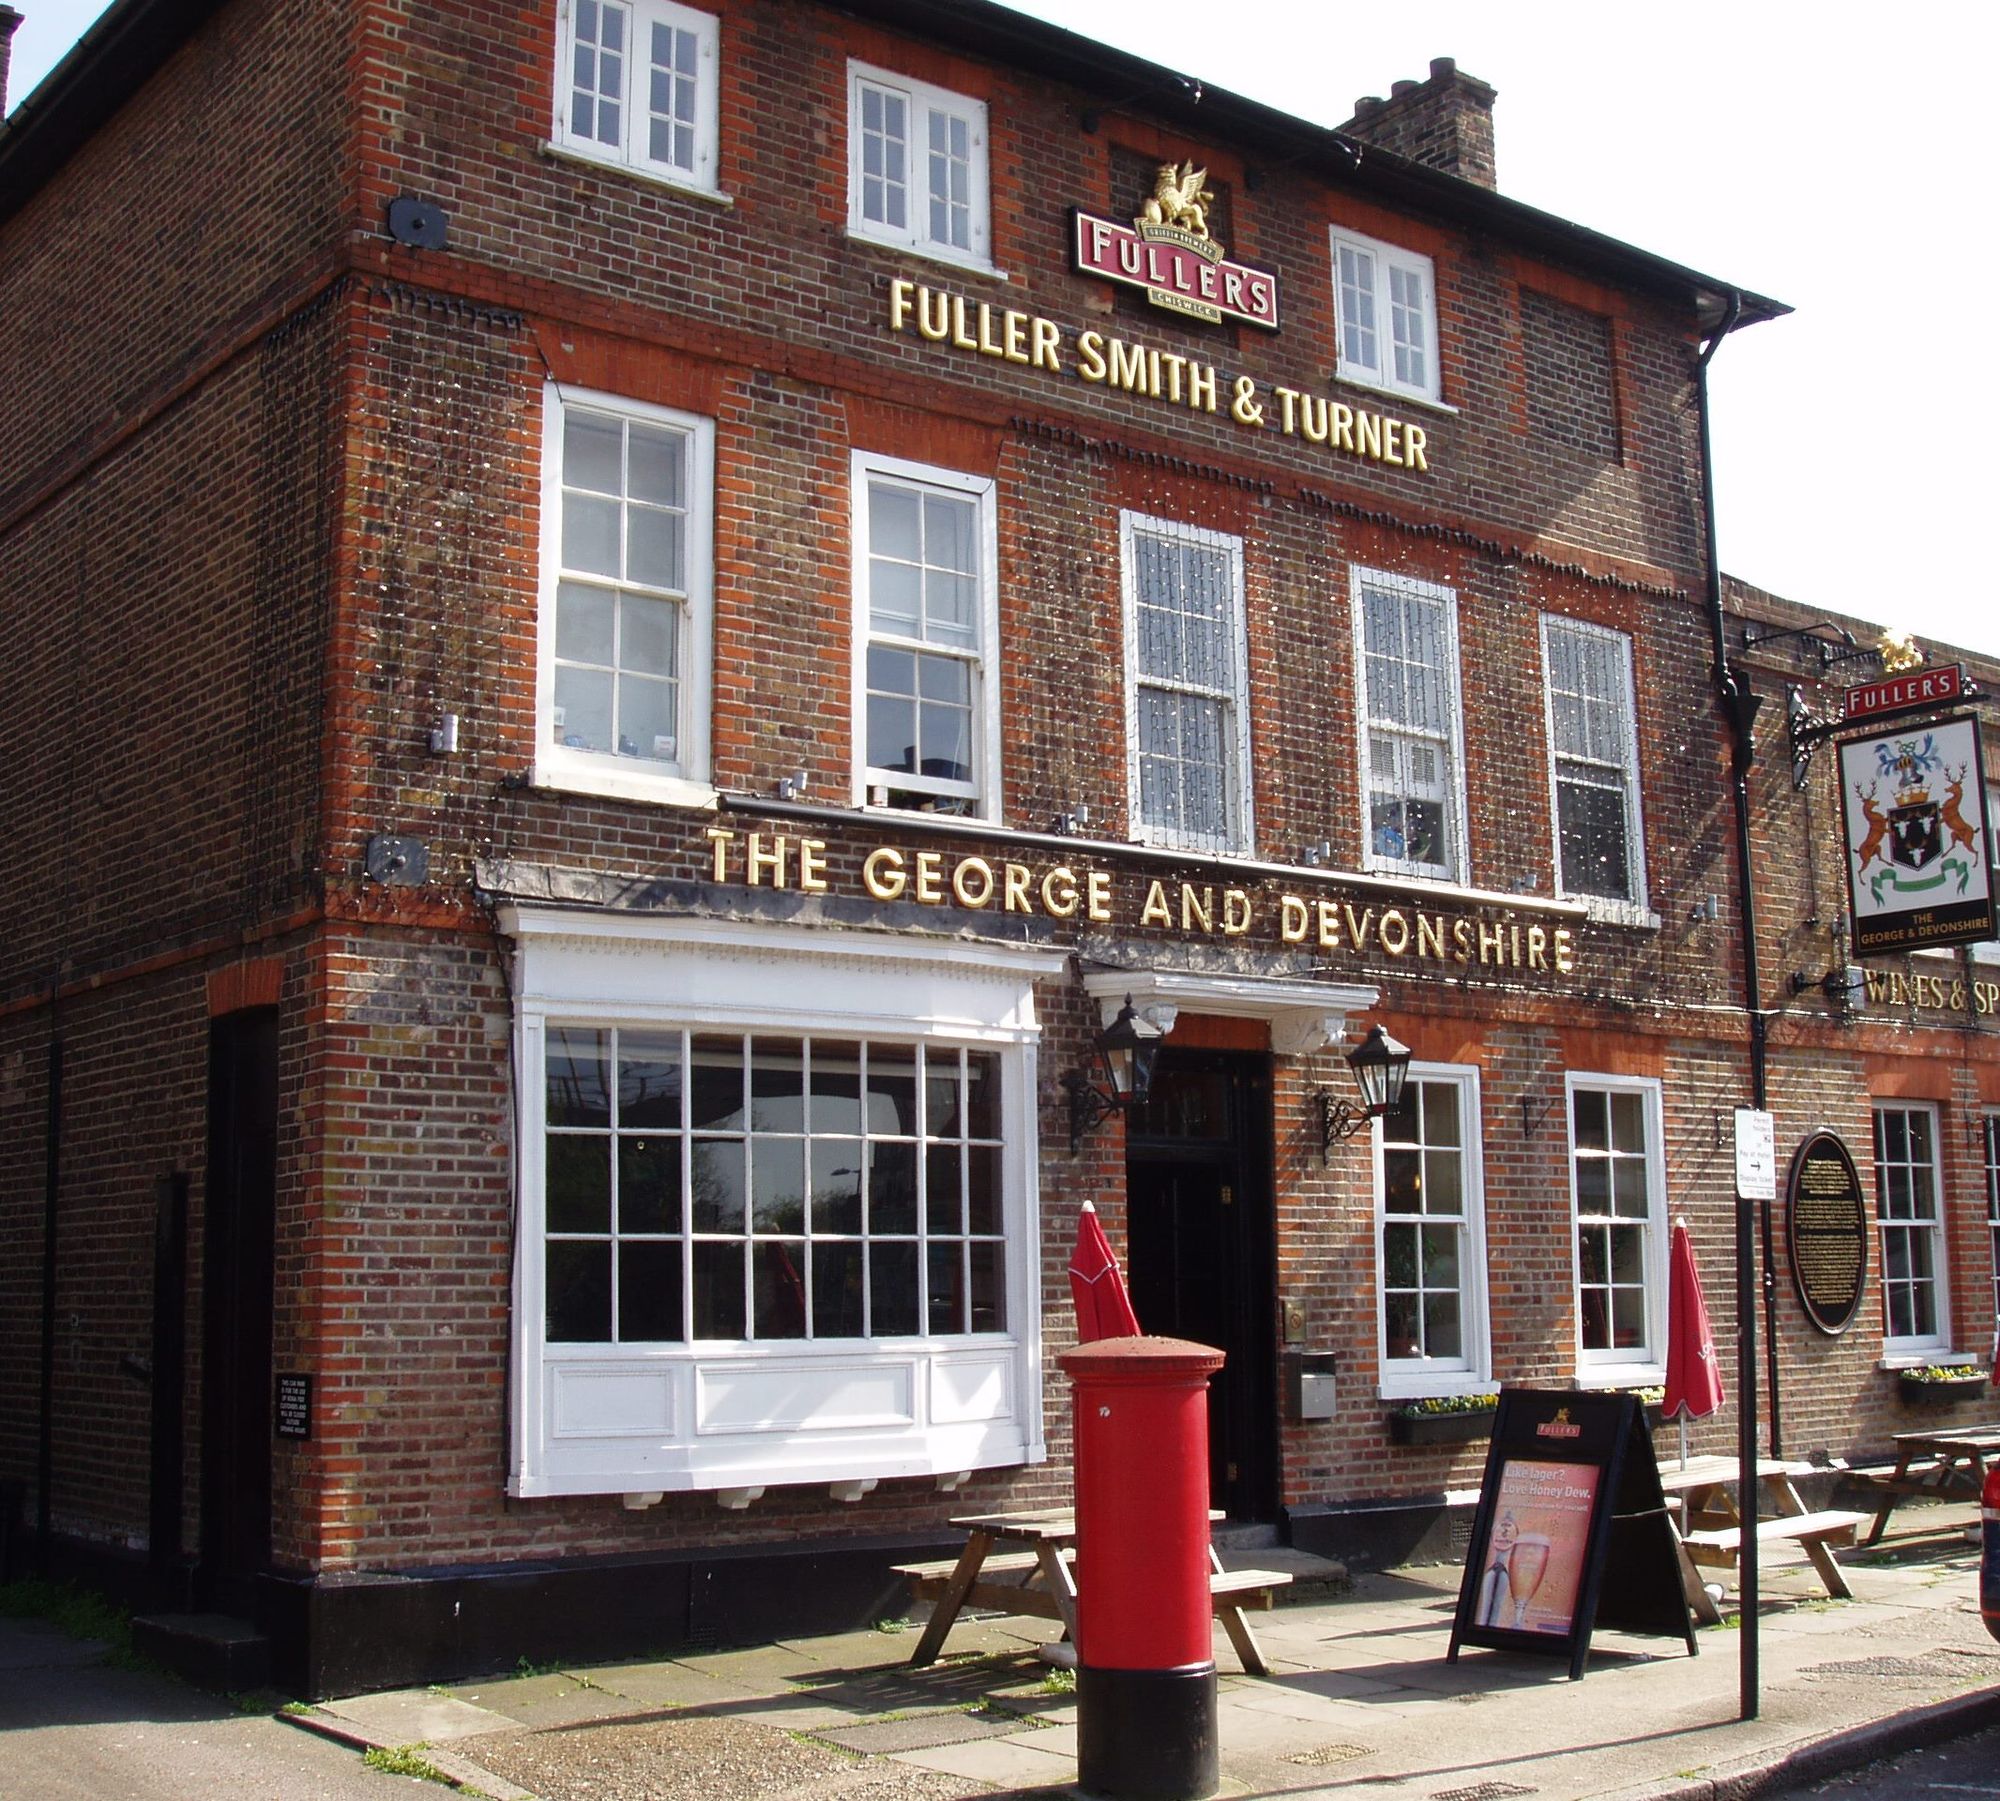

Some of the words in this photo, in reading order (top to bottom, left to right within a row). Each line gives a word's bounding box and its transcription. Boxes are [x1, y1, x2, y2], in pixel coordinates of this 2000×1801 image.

[1092, 221, 1269, 315] FULLER'S
[1157, 293, 1212, 315] CHISWICK
[890, 278, 1060, 372] FULLER
[1077, 330, 1217, 414] SMITH
[1231, 375, 1265, 427] &
[1274, 386, 1428, 472] TURNER
[1850, 674, 1951, 711] FULLER'S
[703, 827, 828, 892] THE
[862, 847, 1111, 922] GEORGE
[1139, 879, 1253, 936] AND
[1281, 894, 1574, 972] DEVONSHIRE
[1860, 929, 1905, 945] GEORGE
[1907, 928, 1916, 938] &
[1918, 917, 1989, 937] DEVONSHIRE
[1912, 912, 1934, 925] THE
[1864, 968, 1944, 1009] WINES
[1950, 979, 1968, 1011] &
[1505, 1465, 1529, 1478] Like
[1530, 1467, 1566, 1481] lager?
[1502, 1482, 1528, 1494] Love
[1529, 1483, 1563, 1499] Honey
[1565, 1485, 1591, 1499] Dew.
